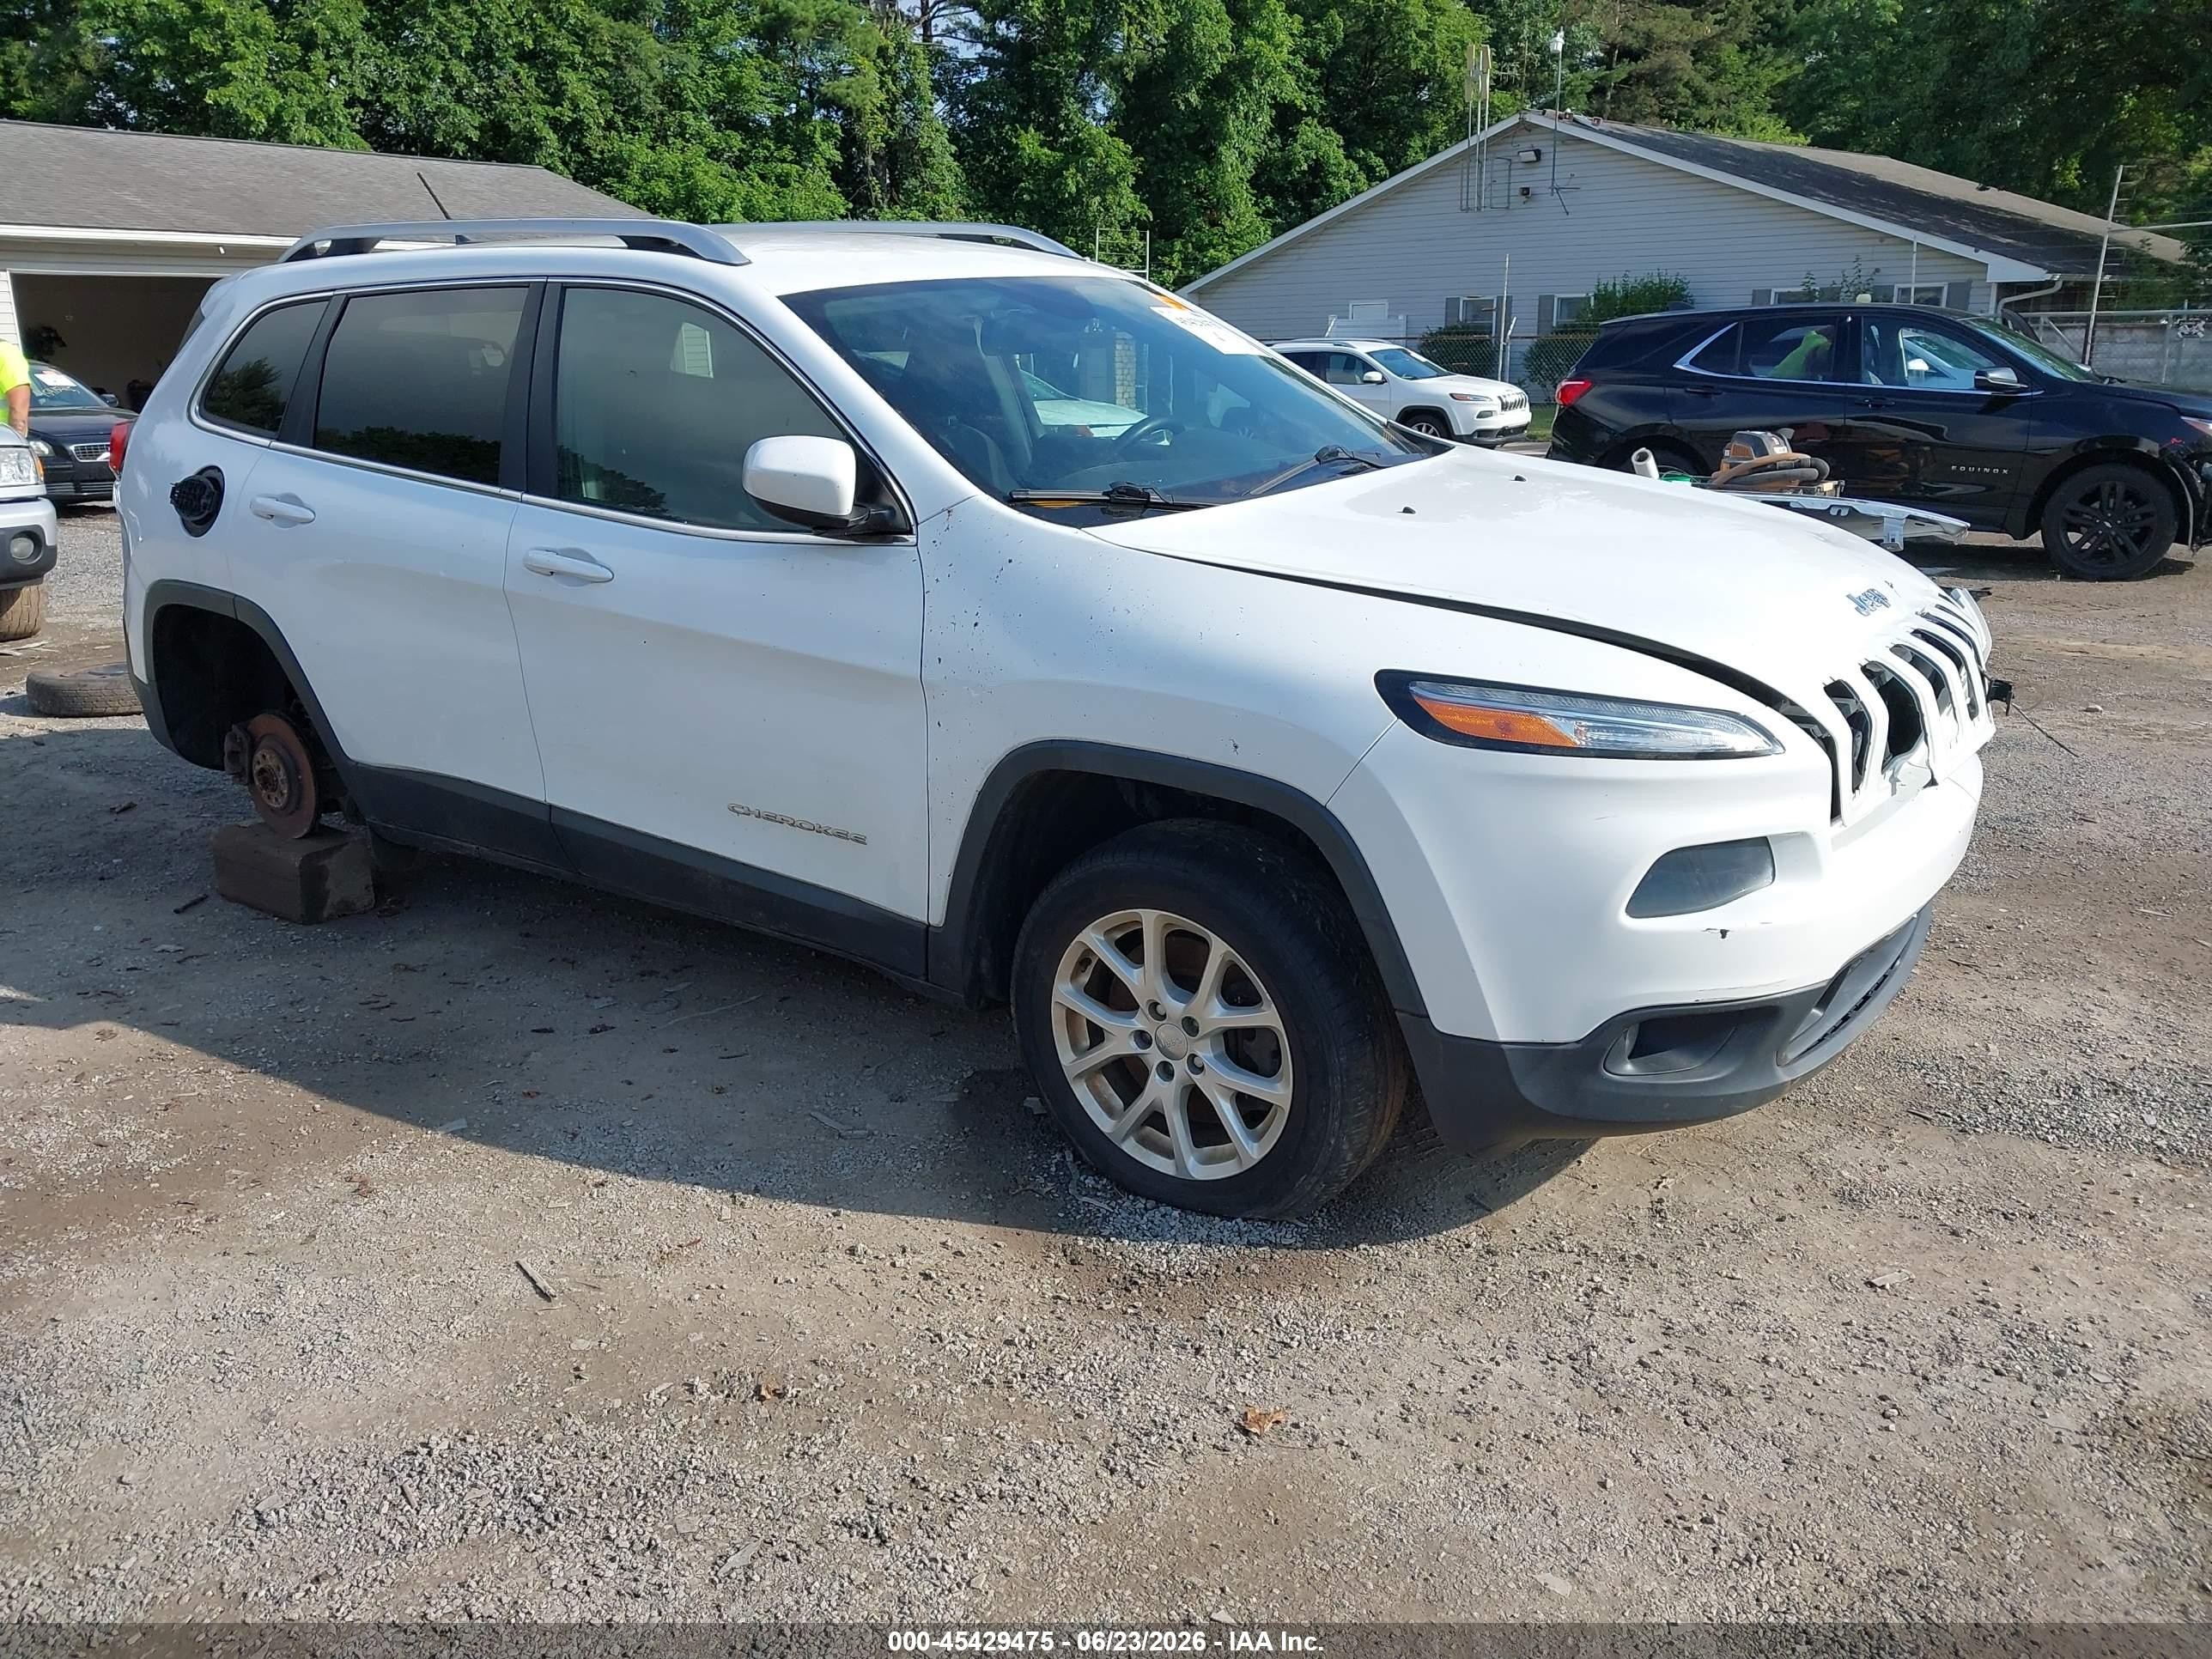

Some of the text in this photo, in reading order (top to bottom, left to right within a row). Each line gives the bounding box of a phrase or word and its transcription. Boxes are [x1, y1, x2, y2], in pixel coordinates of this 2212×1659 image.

[1951, 465, 2008, 475] EQUINOX
[1845, 588, 1891, 617] Jeep
[727, 803, 867, 846] CHEROKEE
